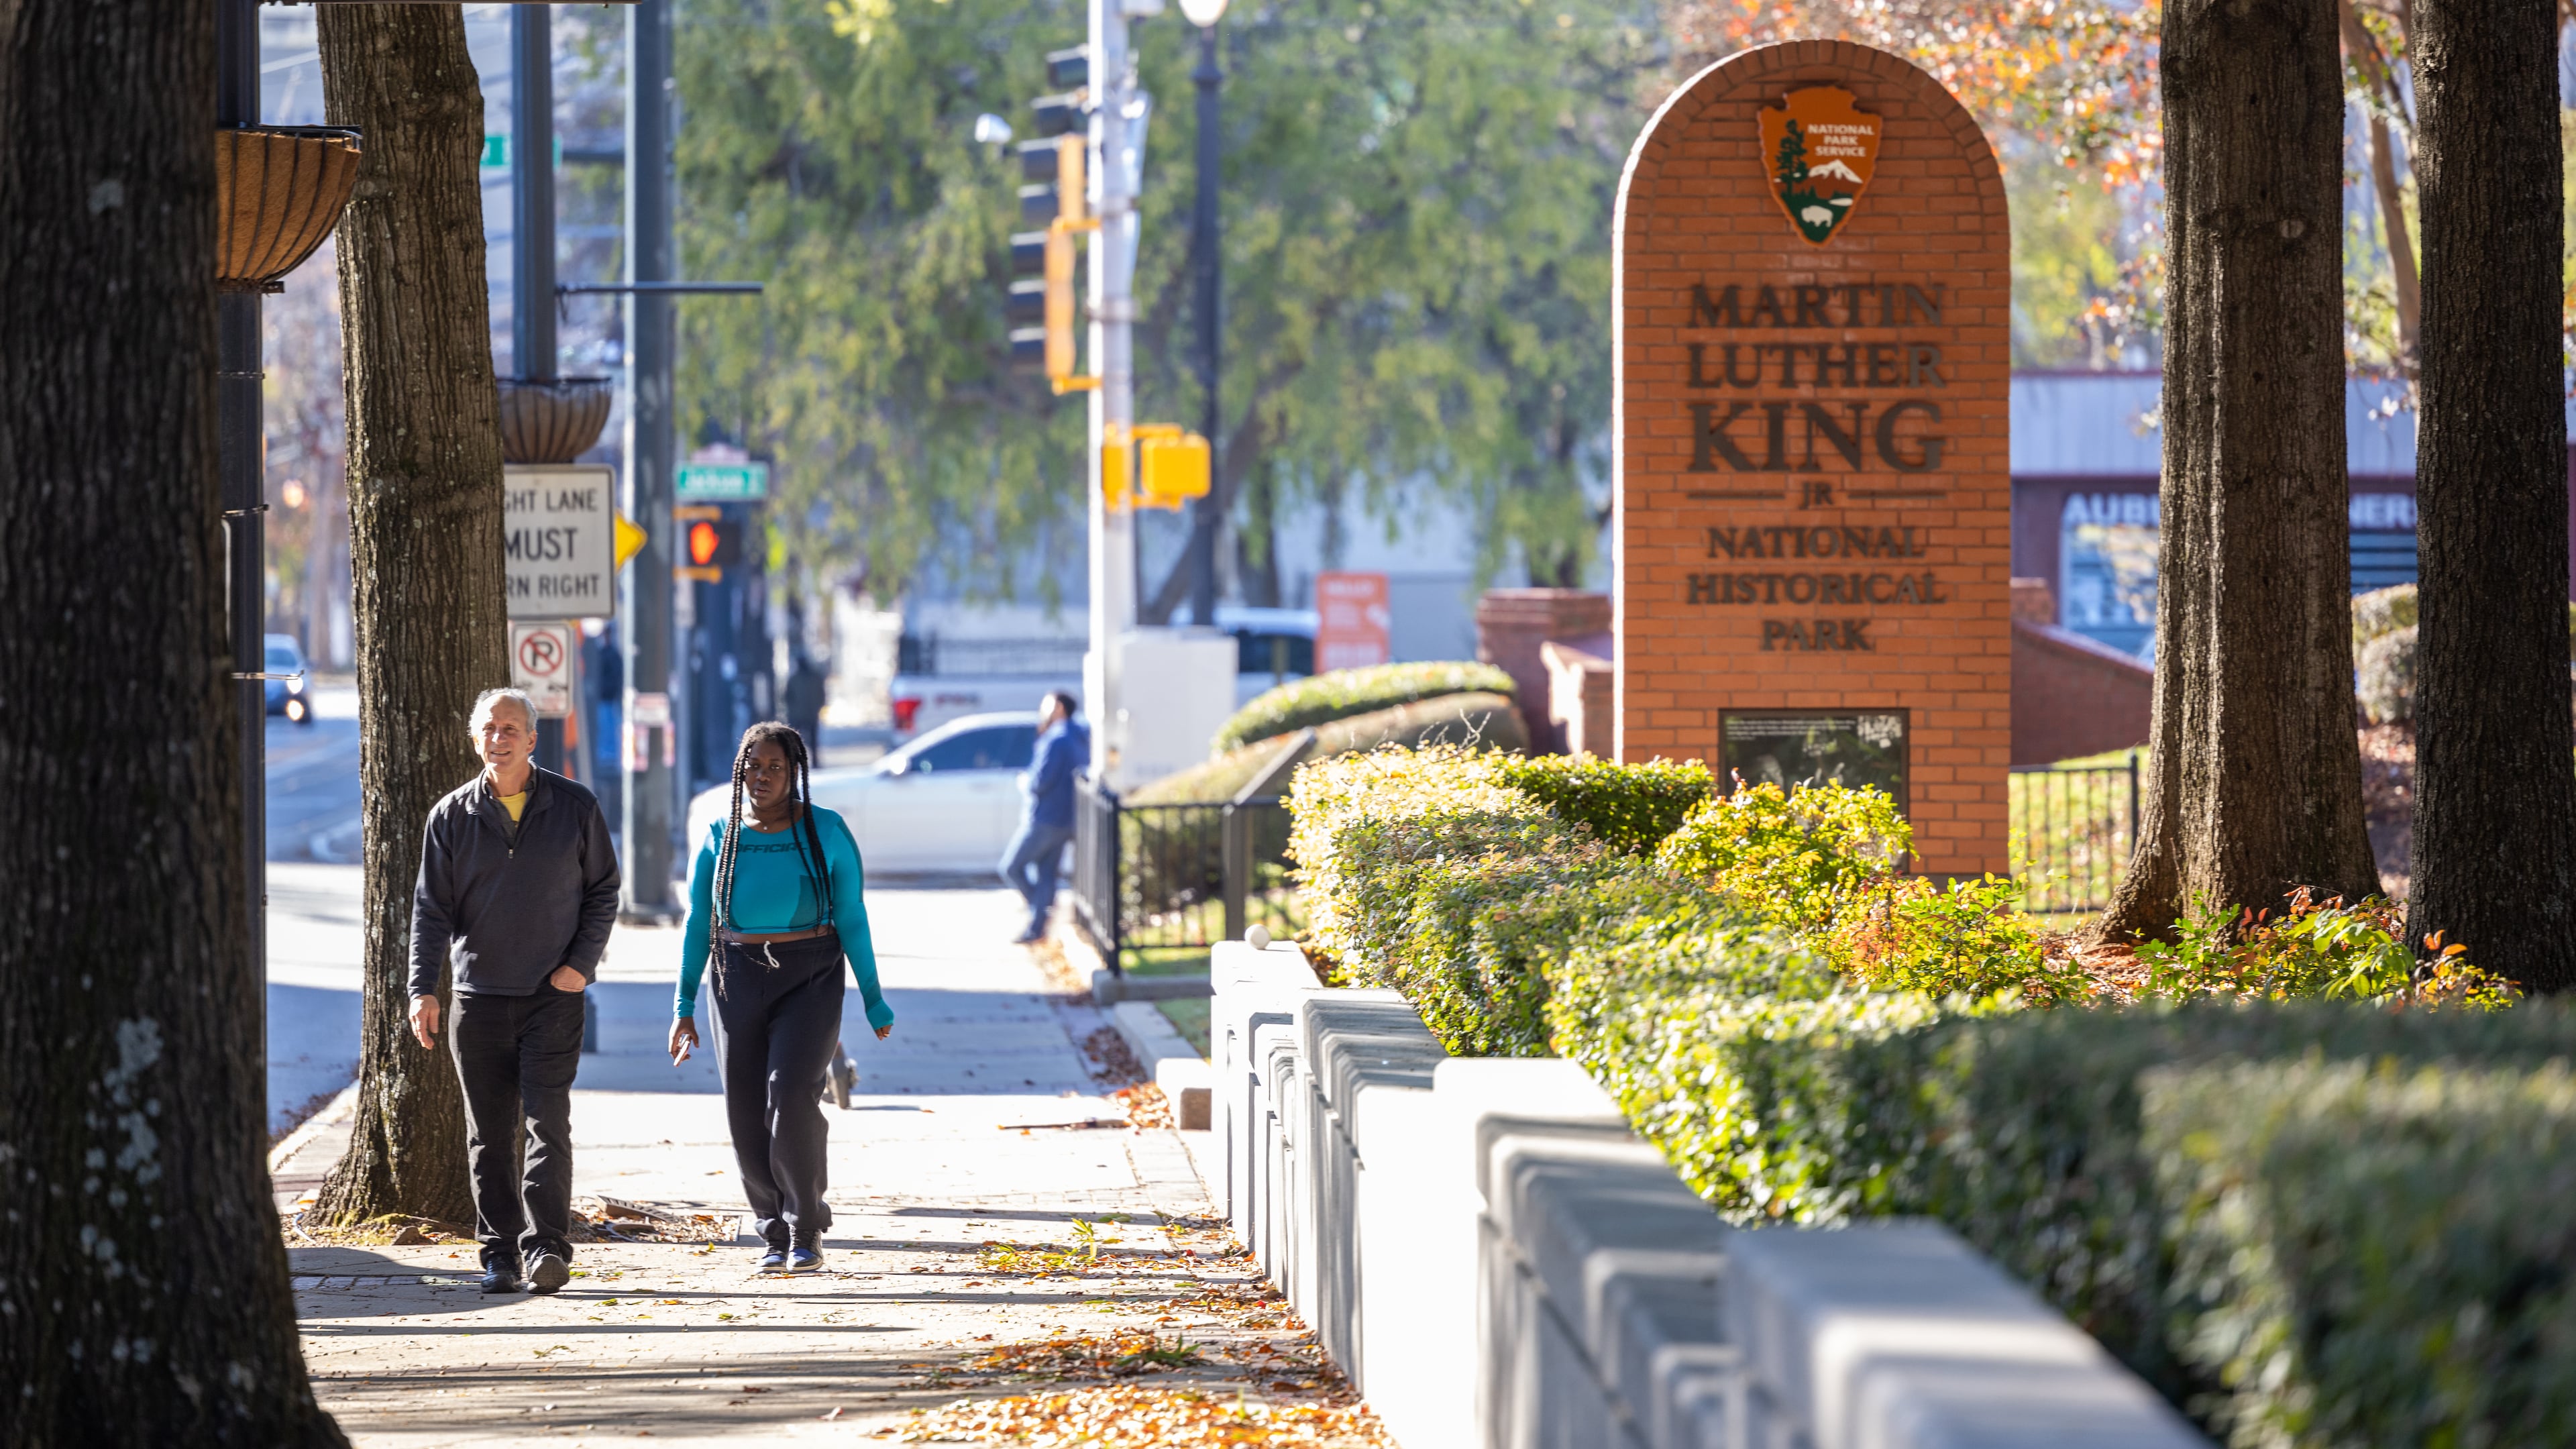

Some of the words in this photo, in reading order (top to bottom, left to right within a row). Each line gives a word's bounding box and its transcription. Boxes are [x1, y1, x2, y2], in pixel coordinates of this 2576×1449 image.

[1808, 124, 1875, 136] NATIONAL
[1823, 135, 1858, 146] PARK
[1815, 146, 1866, 157] SERVICE
[1687, 284, 1946, 329] MARTIN
[1687, 343, 1946, 389] LUTHER
[1686, 400, 1946, 472] KING
[545, 488, 598, 512] LANE
[1799, 482, 1834, 510] JR
[504, 527, 578, 561] MUST
[1707, 527, 1926, 558] NATIONAL
[539, 574, 599, 596] RIGHT
[1687, 574, 1946, 604] HISTORICAL
[1762, 620, 1872, 651] PARK
